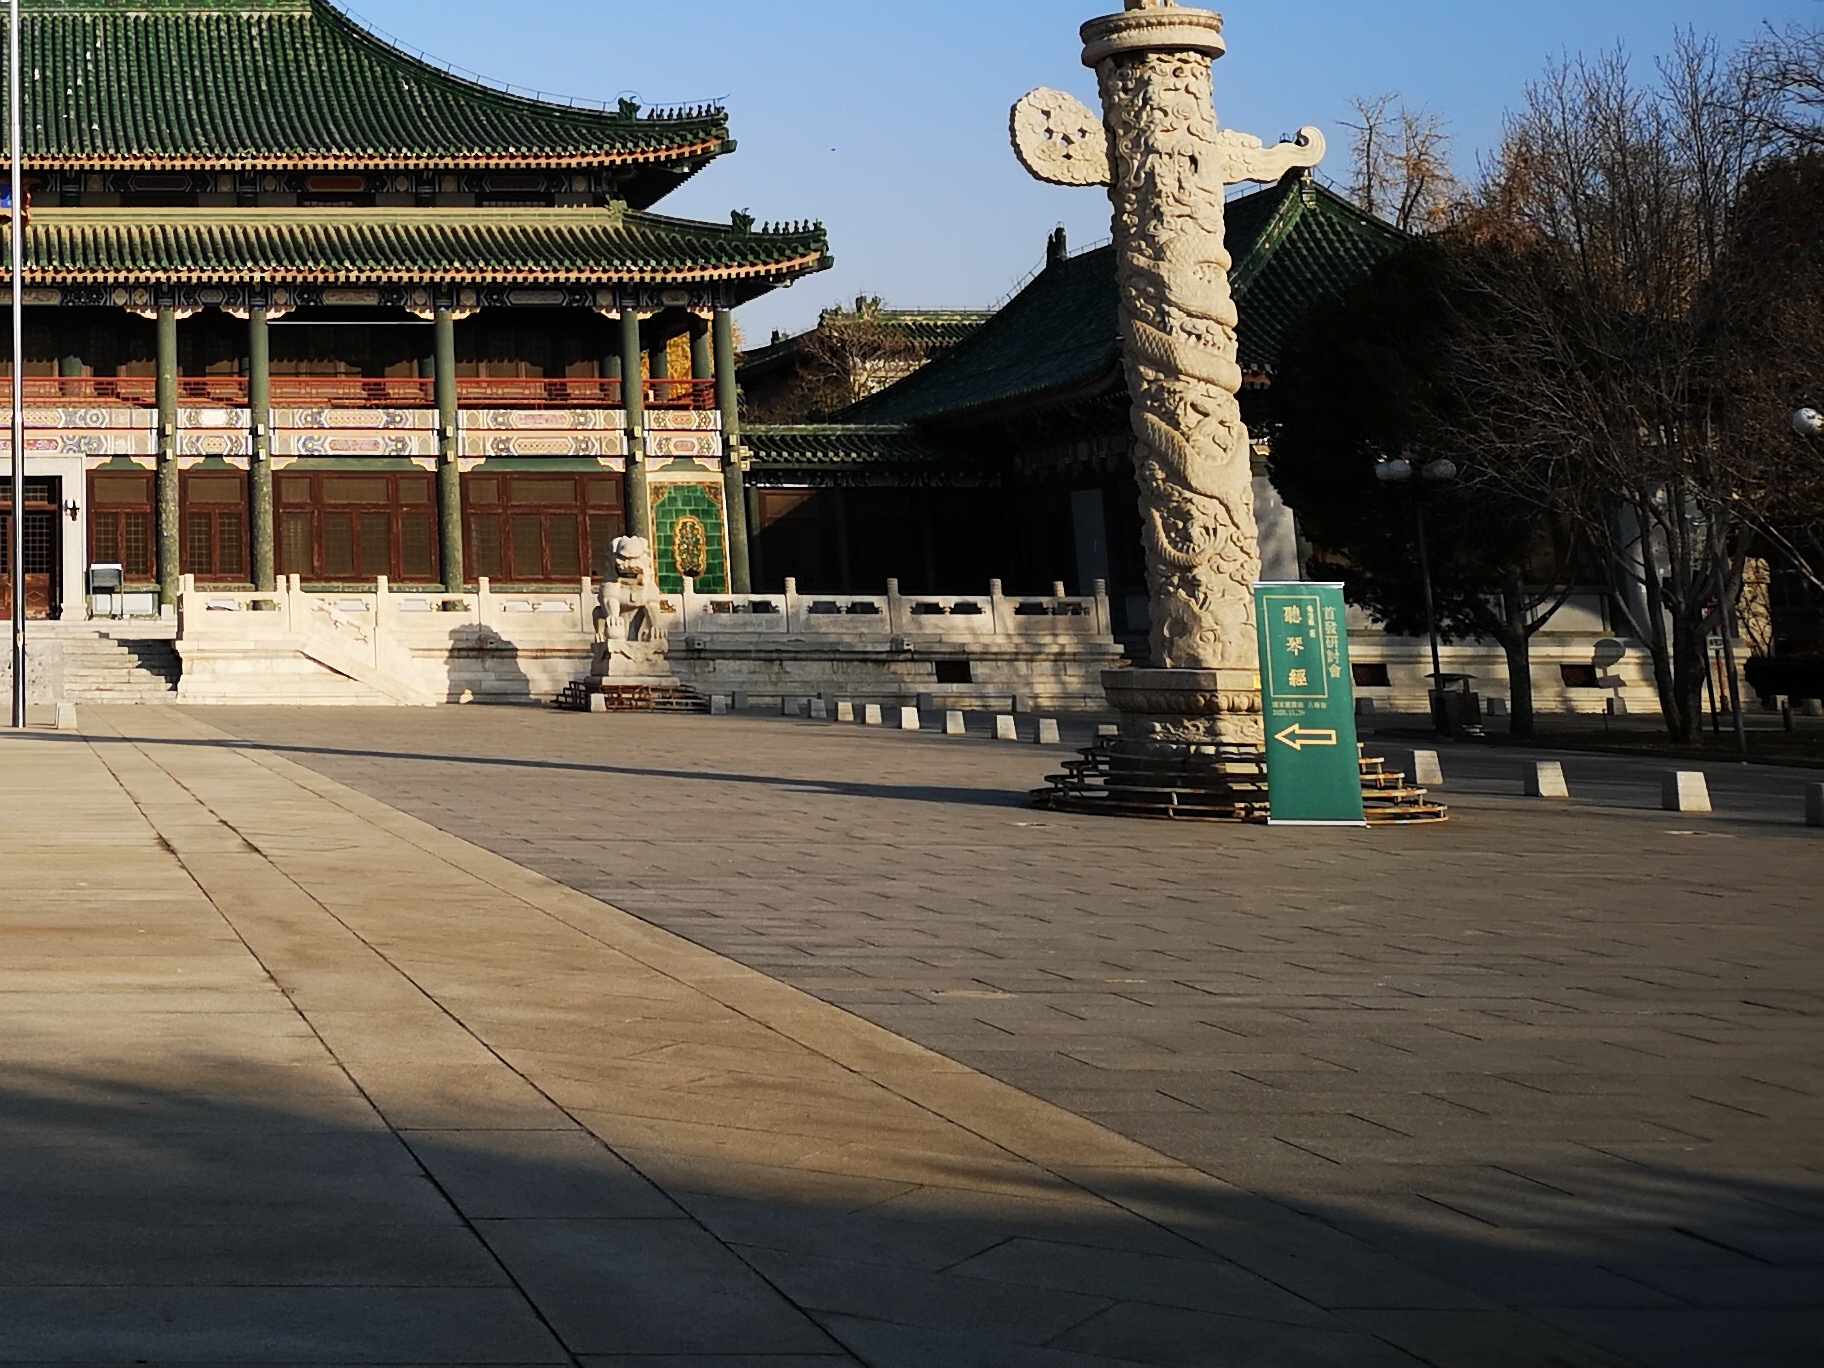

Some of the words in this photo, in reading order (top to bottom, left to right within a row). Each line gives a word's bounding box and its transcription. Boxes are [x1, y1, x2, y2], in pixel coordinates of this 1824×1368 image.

[1322, 605, 1342, 679] 首發研討會
